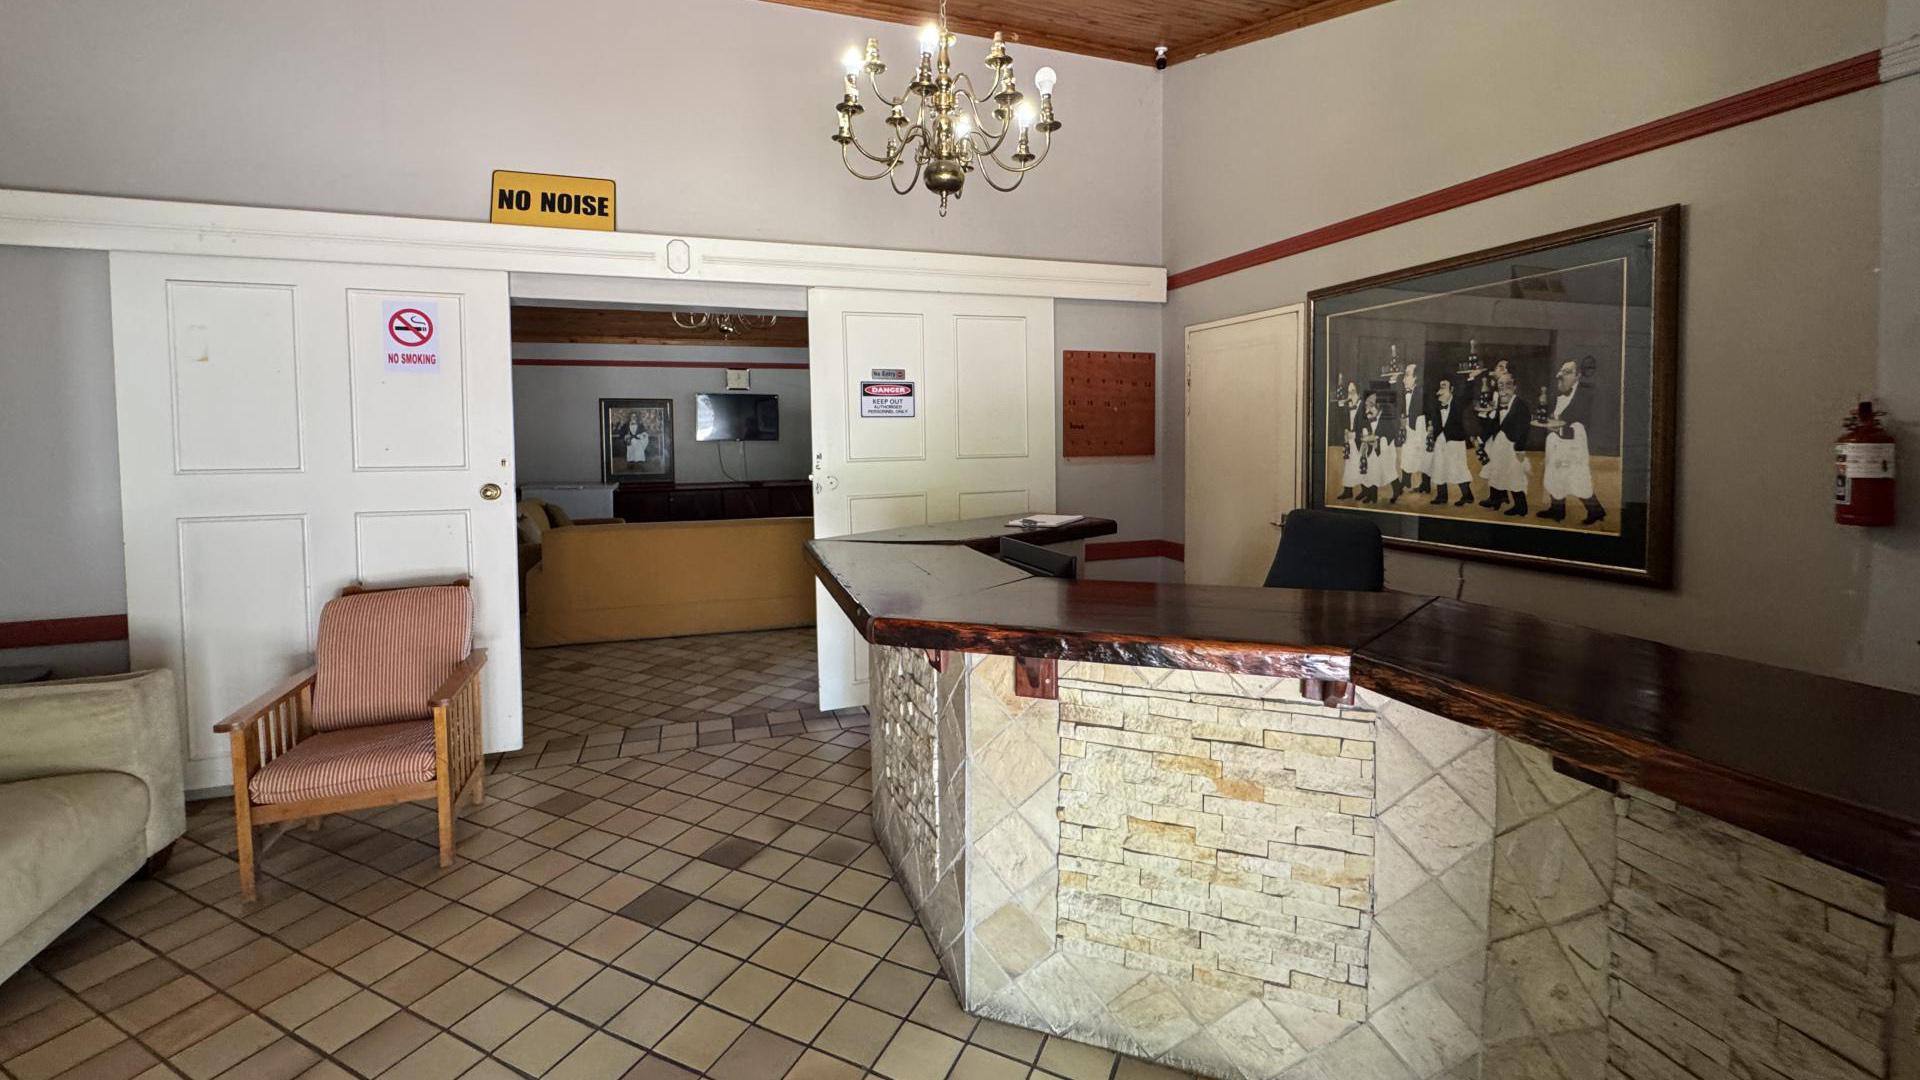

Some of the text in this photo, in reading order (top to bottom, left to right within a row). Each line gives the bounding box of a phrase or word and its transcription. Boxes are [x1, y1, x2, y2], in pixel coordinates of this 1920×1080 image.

[498, 189, 609, 216] NO NOISE
[388, 353, 436, 365] NO SMOKING
